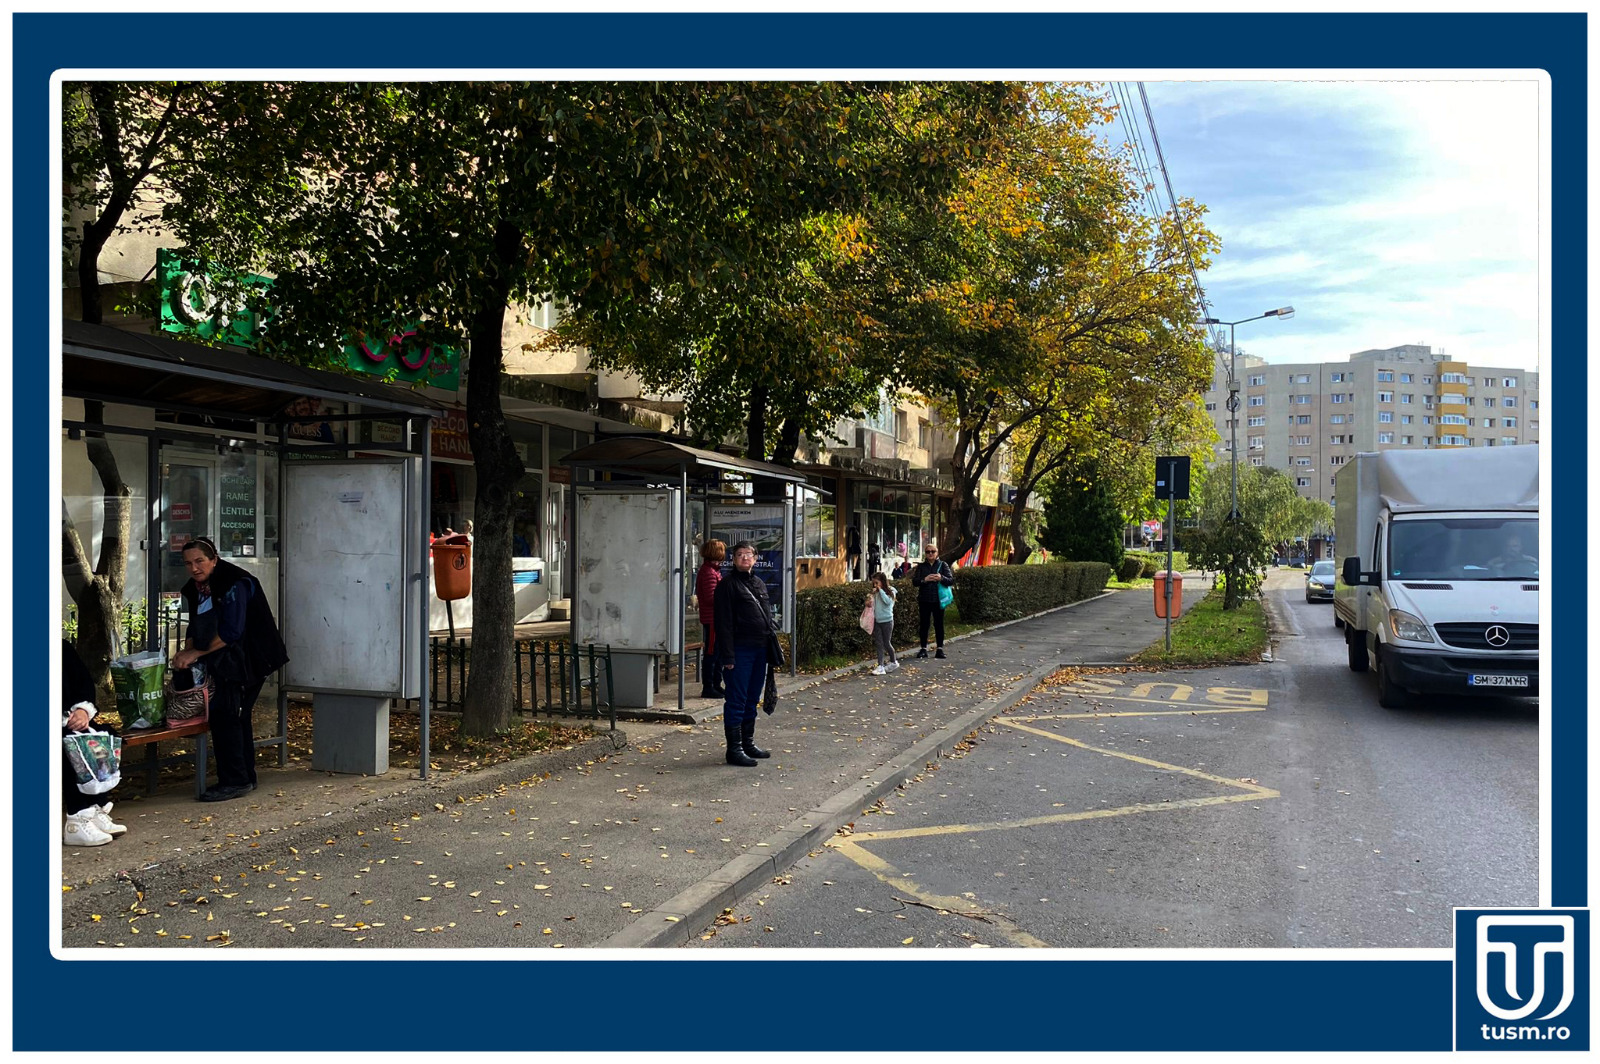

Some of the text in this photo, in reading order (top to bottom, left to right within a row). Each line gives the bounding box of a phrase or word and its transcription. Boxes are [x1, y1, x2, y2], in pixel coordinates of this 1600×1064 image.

[431, 416, 469, 433] SECO
[226, 492, 249, 501] RAME
[221, 507, 254, 516] LENTILE
[221, 521, 255, 529] ACCESORII
[1474, 675, 1527, 685] SM 37 MYR
[1060, 677, 1269, 706] BUS
